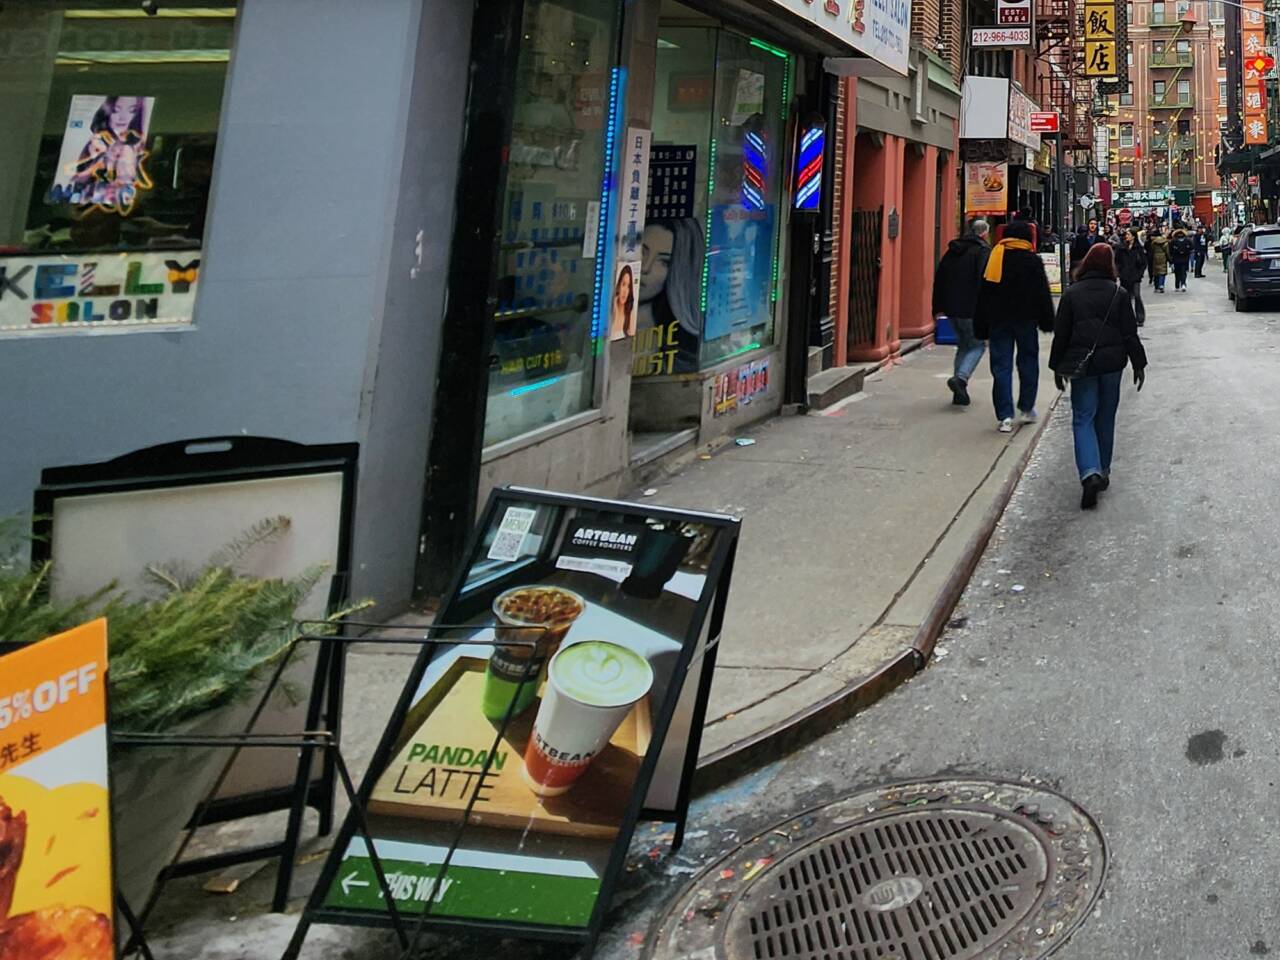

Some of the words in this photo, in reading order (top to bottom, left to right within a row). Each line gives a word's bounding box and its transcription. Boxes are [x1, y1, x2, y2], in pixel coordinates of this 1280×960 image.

[973, 30, 1029, 43] 212-966-4033
[31, 298, 158, 324] SALON
[573, 538, 597, 548] COFFEE
[599, 541, 633, 552] ROASTERS
[574, 527, 637, 546] ARTBEAN
[533, 724, 597, 762] RTBEAN
[407, 743, 508, 771] PANDAN
[393, 765, 500, 802] LATTE
